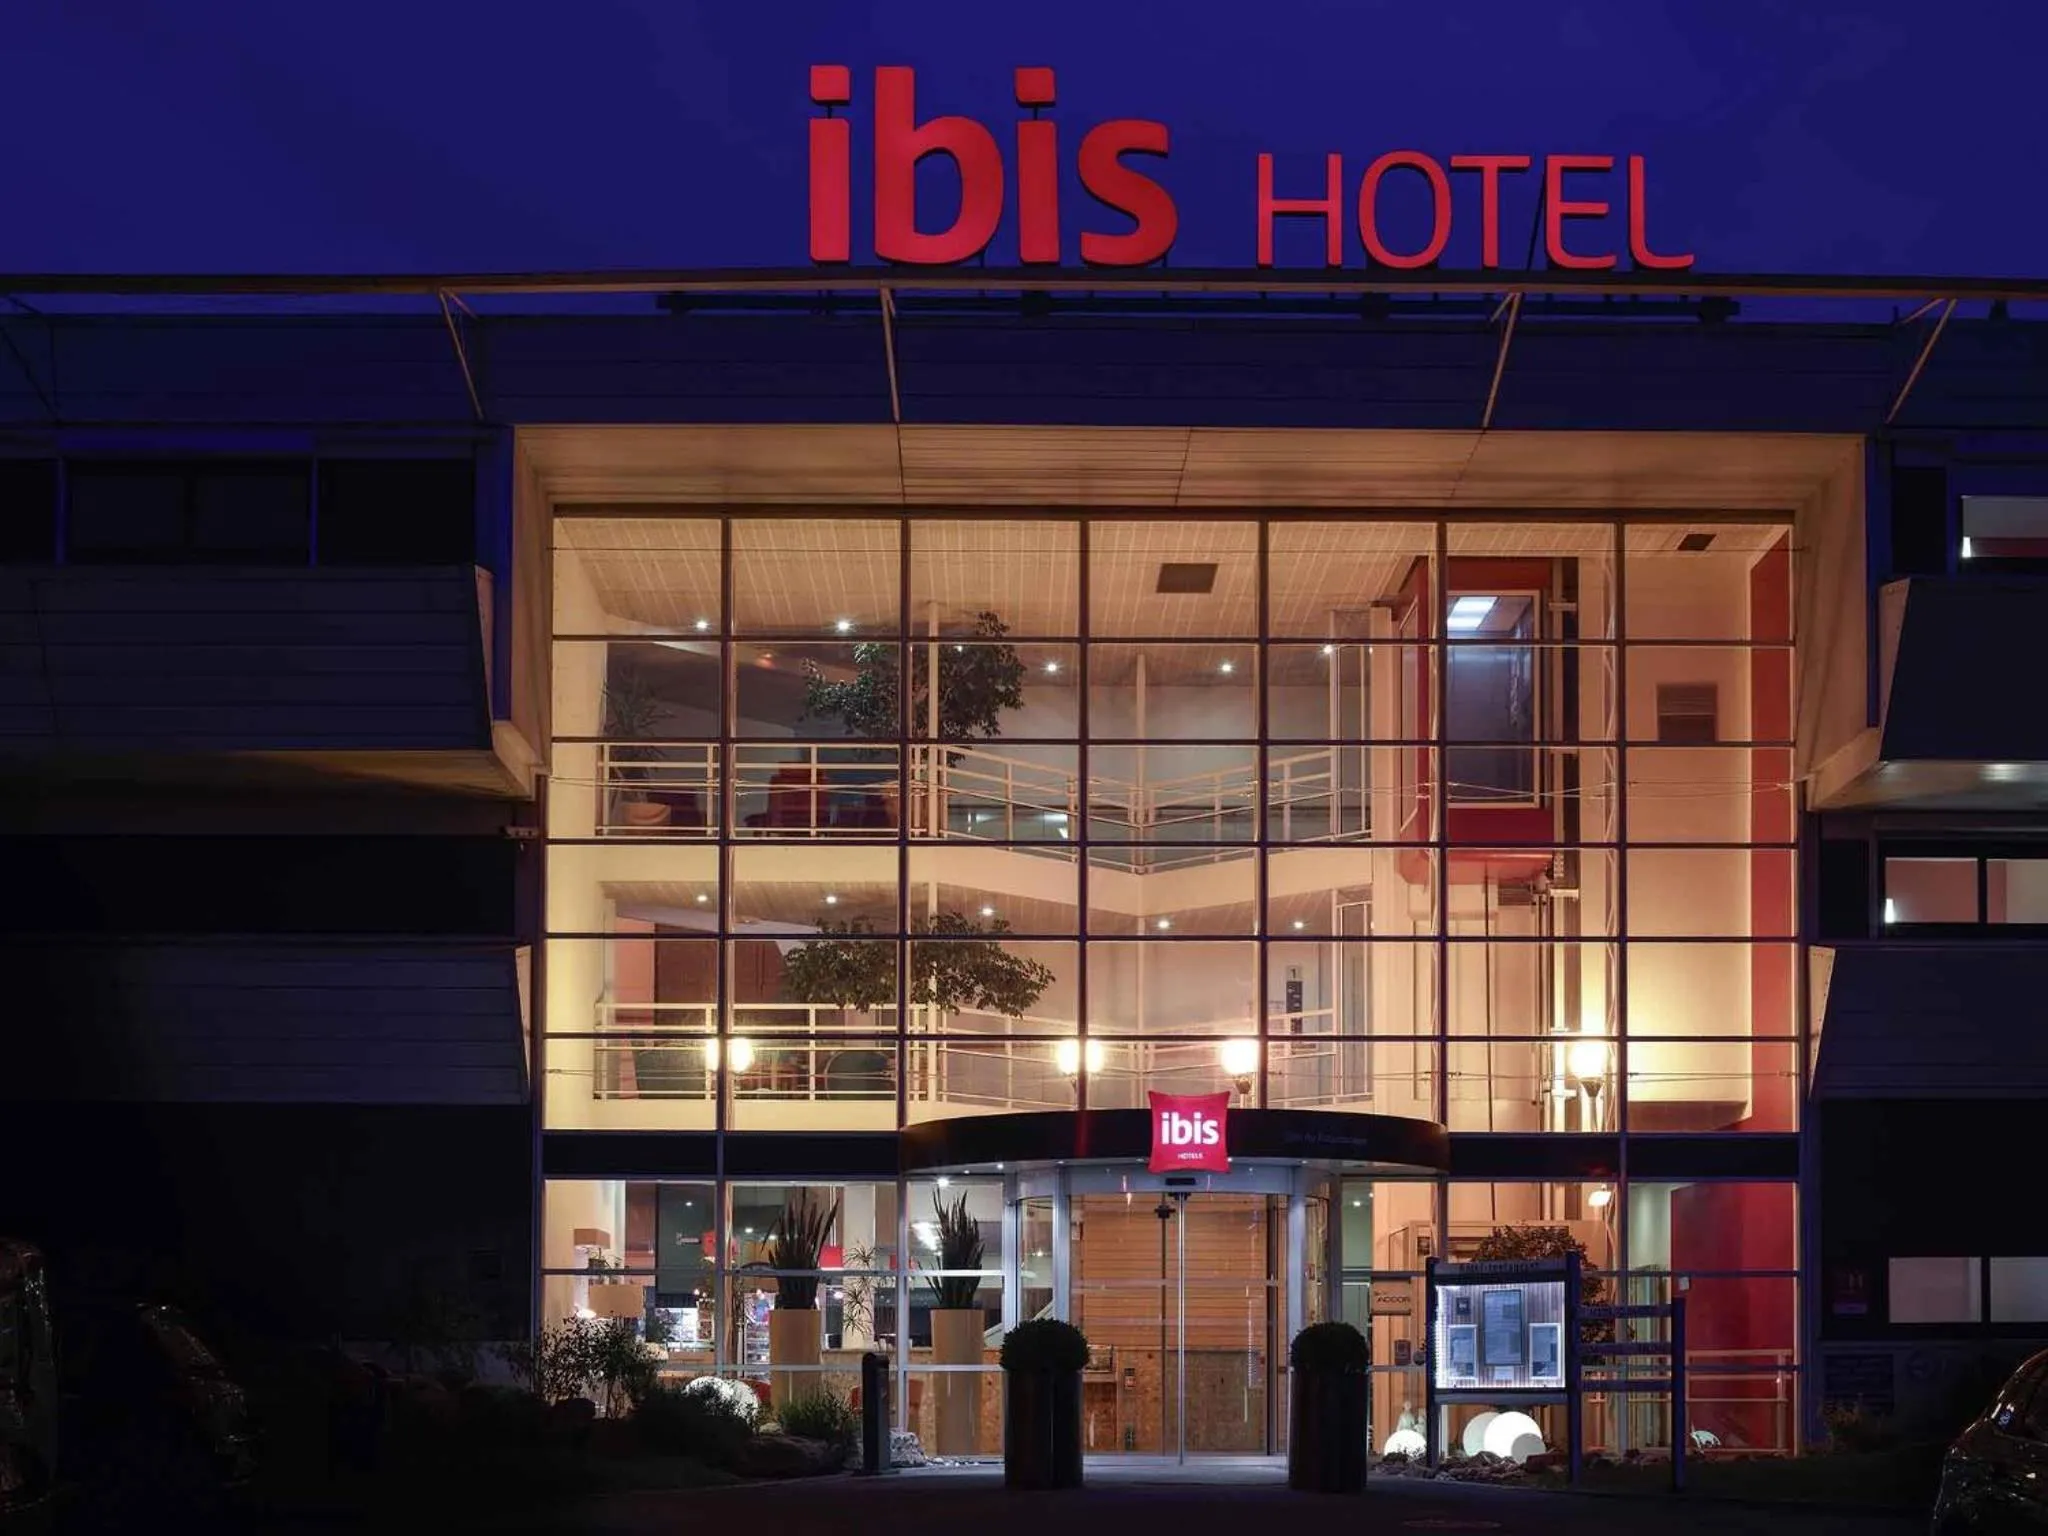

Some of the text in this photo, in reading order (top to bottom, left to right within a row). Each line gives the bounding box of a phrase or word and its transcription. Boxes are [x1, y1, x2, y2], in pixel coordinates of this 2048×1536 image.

[809, 65, 1695, 270] ibis HOTEL
[1160, 1111, 1219, 1145] ibis
[1177, 1152, 1203, 1160] HOTELS
